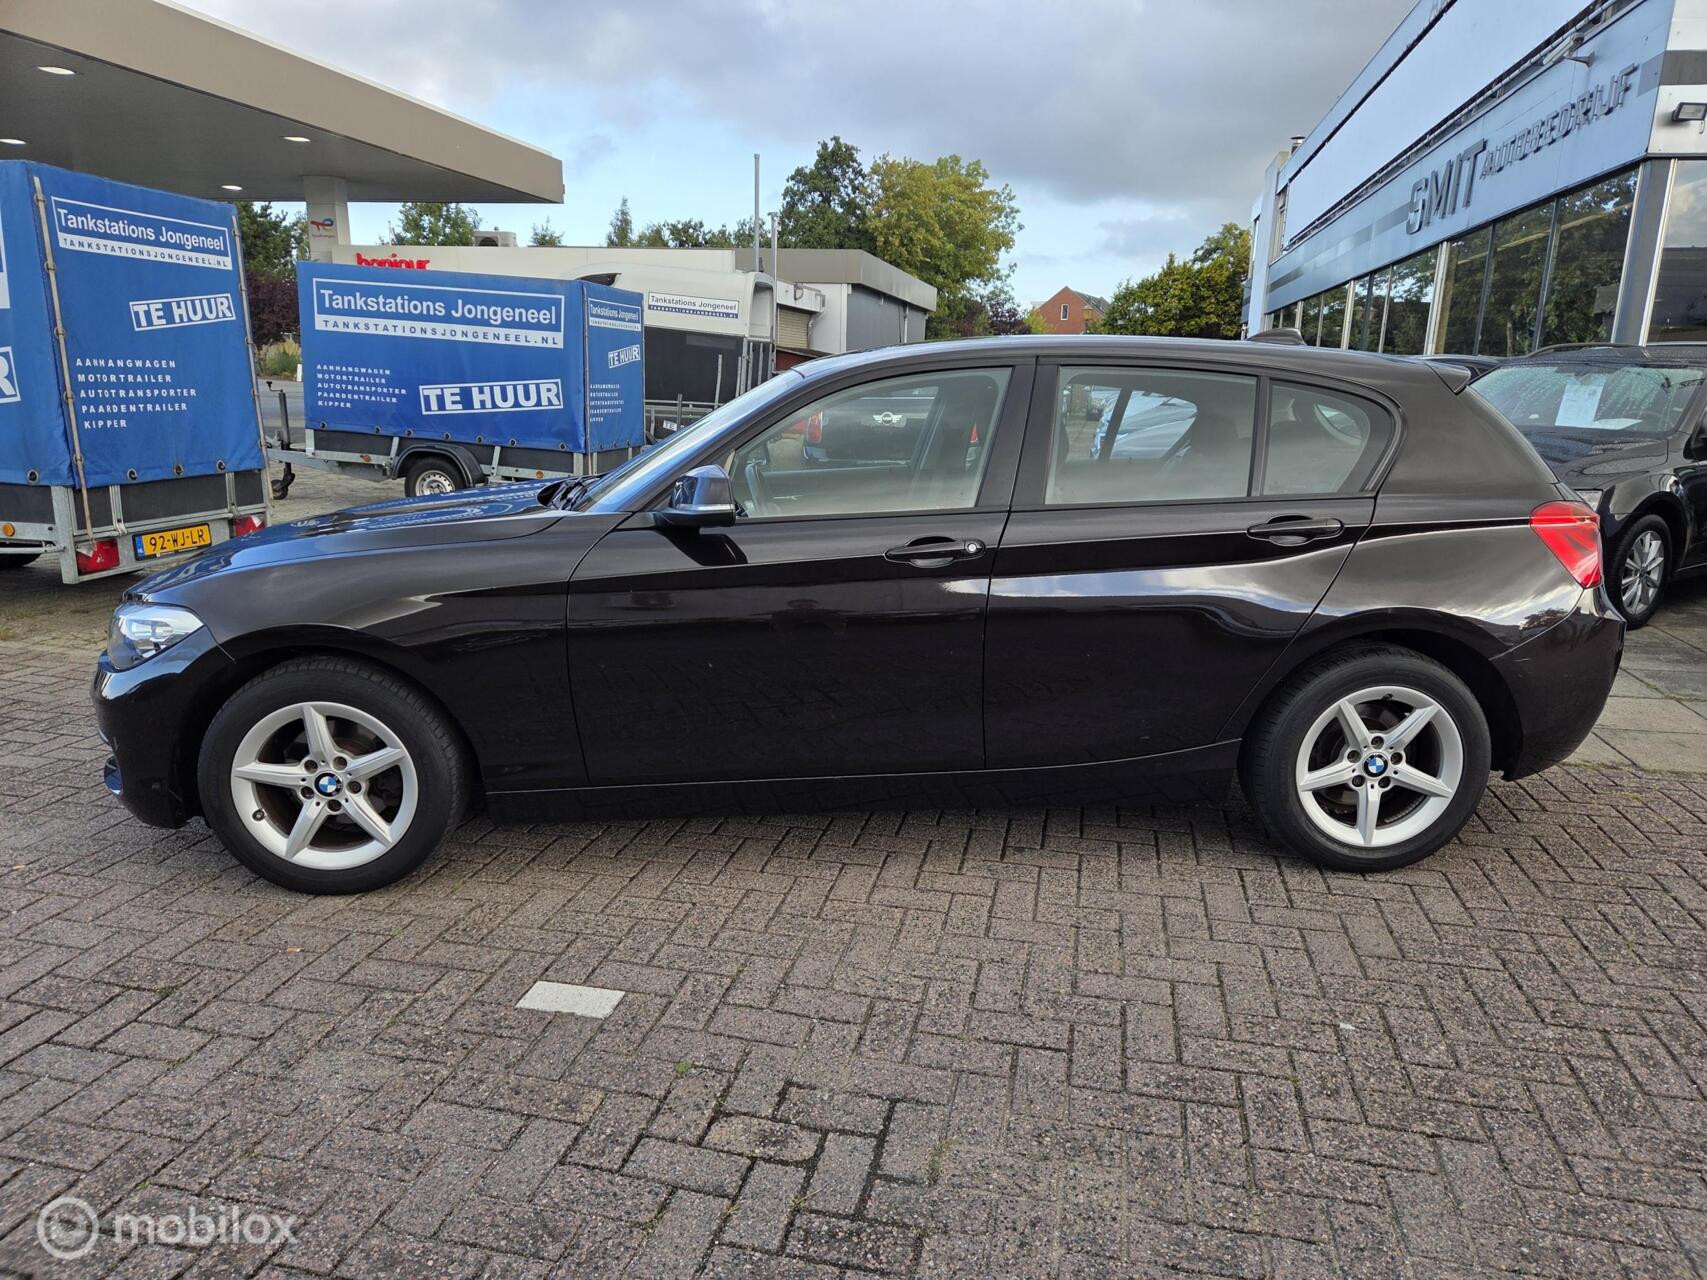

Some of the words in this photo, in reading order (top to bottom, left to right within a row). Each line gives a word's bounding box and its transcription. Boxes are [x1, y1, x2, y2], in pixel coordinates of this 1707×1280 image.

[1406, 138, 1488, 235] SMIT
[1479, 62, 1638, 180] AUTOBEDRIJF
[57, 208, 156, 241] Tankstations
[159, 226, 225, 251] Jongeneel
[62, 237, 228, 268] TANKSTATIONSJONGENEEL.NL
[133, 303, 167, 327] TE
[171, 297, 233, 323] HUUR
[320, 289, 446, 316] Tankstations
[451, 299, 556, 325] Jongeneel
[651, 295, 697, 307] Tankstations
[699, 300, 736, 311] Jongeneel
[323, 319, 559, 346] TANKSTATIONSJONGENEEL.NL
[75, 358, 176, 369] AANHANGWAGEN
[609, 352, 619, 366] TE
[620, 346, 639, 362] HUUR
[77, 374, 172, 383] MOTORTRAILER
[316, 364, 391, 376] AANHANGWAGEN
[316, 373, 386, 384] MOTORTRAILER
[80, 388, 197, 398] AUTOTRANSPORTER
[423, 387, 463, 411] TE
[471, 383, 561, 409] HUUR
[81, 402, 188, 414] PAARDENTRAILER
[318, 400, 352, 408] KIPPER
[84, 419, 128, 430] KIPPER
[149, 528, 206, 552] 92-WJ-LR
